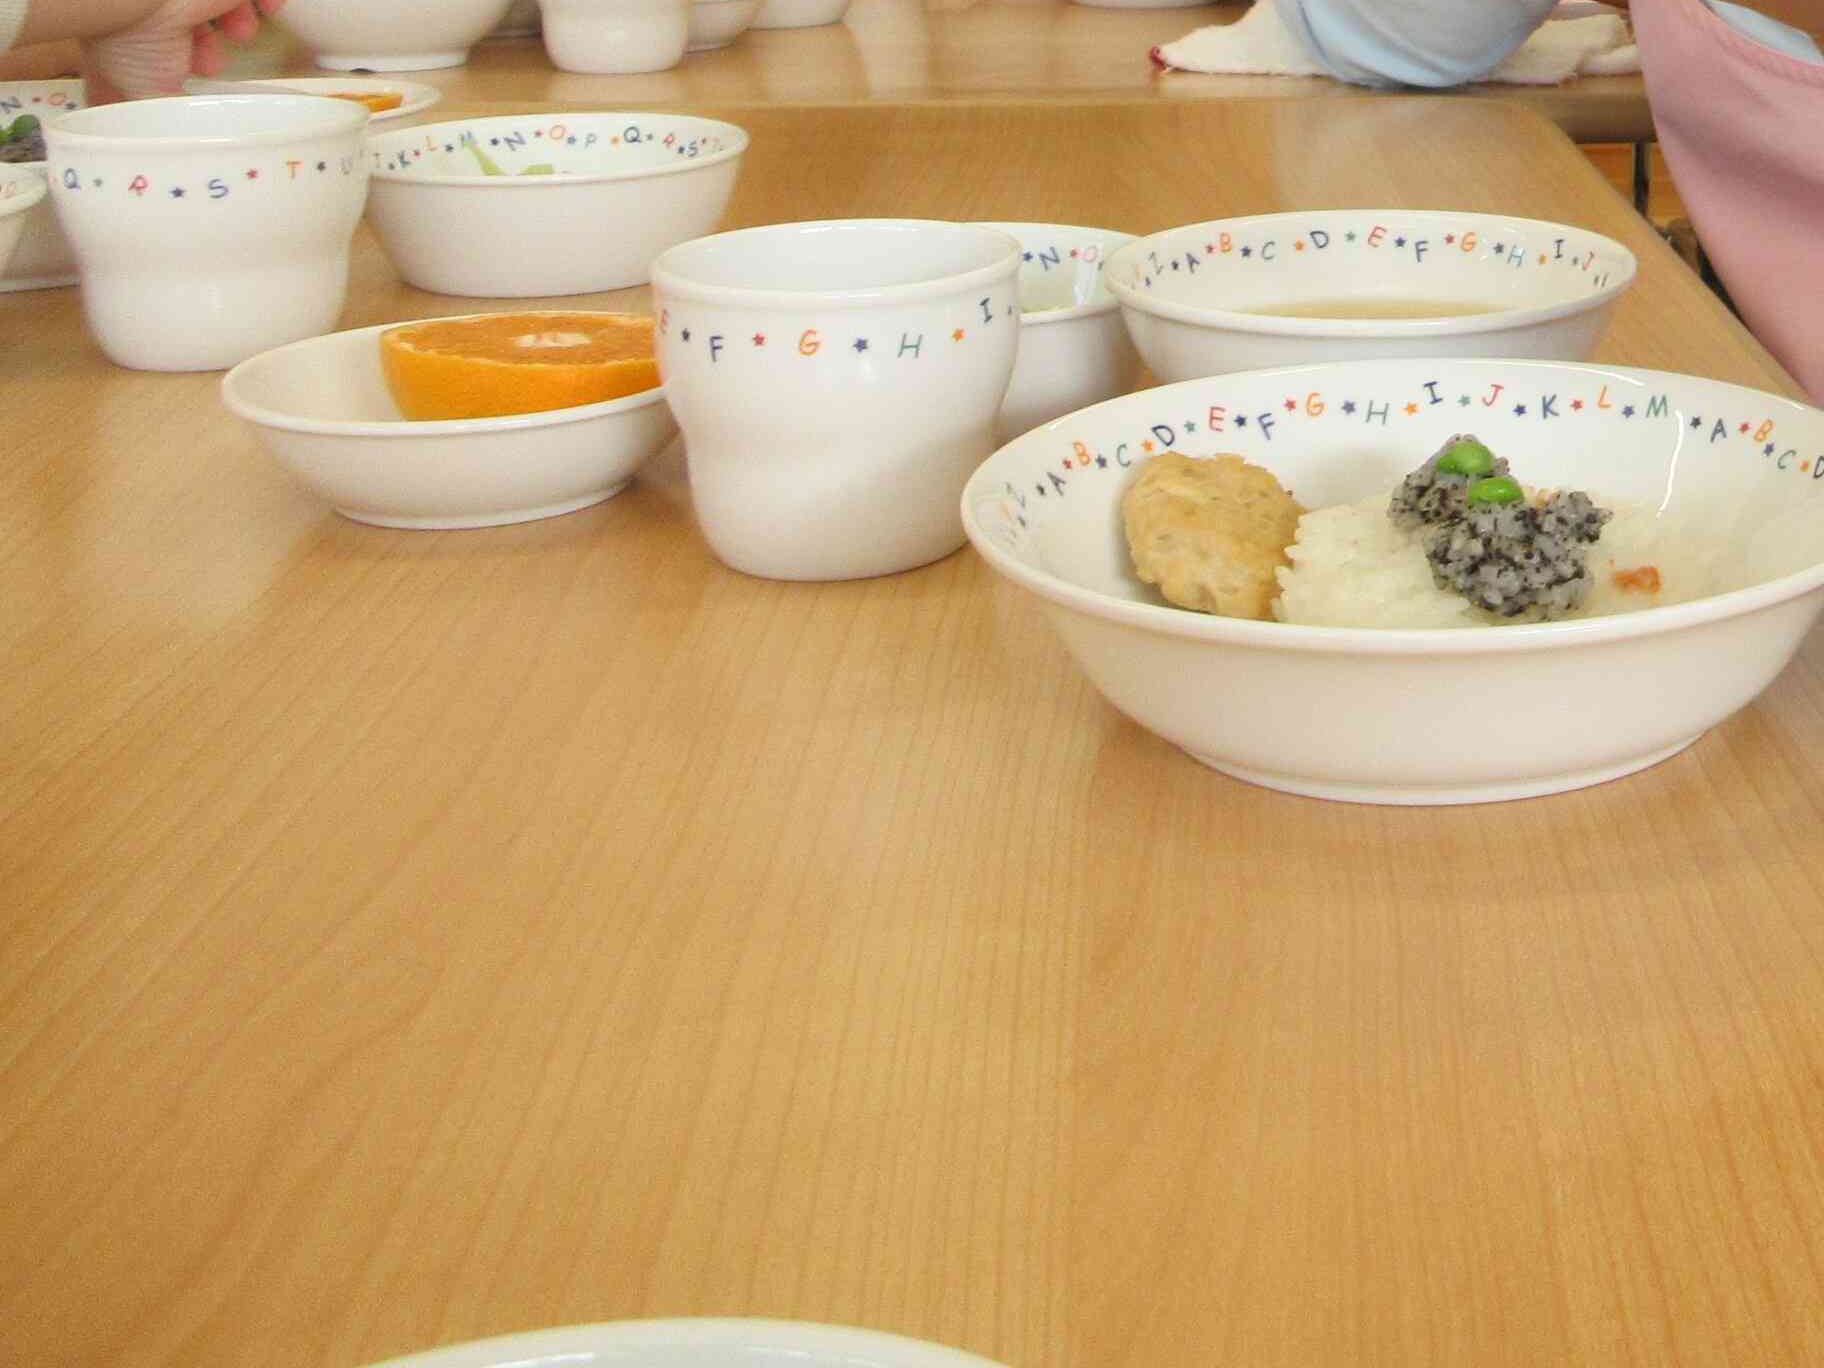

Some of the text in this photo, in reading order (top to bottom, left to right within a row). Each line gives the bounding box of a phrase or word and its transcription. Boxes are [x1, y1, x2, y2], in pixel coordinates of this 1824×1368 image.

[397, 149, 411, 169] K
[503, 131, 527, 152] N
[549, 124, 566, 141] O
[623, 125, 642, 144] Q
[686, 140, 699, 158] S
[63, 167, 81, 190] Q
[128, 174, 150, 197] R
[207, 178, 230, 199] S
[285, 160, 303, 180] T
[1038, 246, 1061, 271] N
[1185, 252, 1200, 273] A
[1219, 232, 1233, 253] B
[1260, 241, 1276, 260] C
[1310, 230, 1330, 249] D
[1367, 225, 1388, 248] E
[1414, 240, 1428, 263] F
[1460, 232, 1477, 253] G
[1507, 244, 1526, 267] H
[1552, 239, 1565, 259] I
[709, 335, 724, 363] F
[798, 329, 821, 357] G
[897, 332, 924, 359] H
[978, 297, 993, 324] I
[1046, 471, 1067, 497] A
[1072, 440, 1091, 466] B
[1115, 443, 1132, 468] C
[1151, 424, 1175, 447] D
[1208, 406, 1227, 432] E
[1256, 412, 1276, 441] F
[1305, 392, 1326, 417] G
[1364, 399, 1390, 426] H
[1423, 381, 1443, 405] I
[1481, 383, 1504, 408] J
[1541, 393, 1560, 420] K
[1597, 385, 1612, 409] L
[1645, 395, 1669, 418] M
[1709, 417, 1728, 443] A
[1753, 419, 1774, 443] B
[1776, 449, 1797, 470] C
